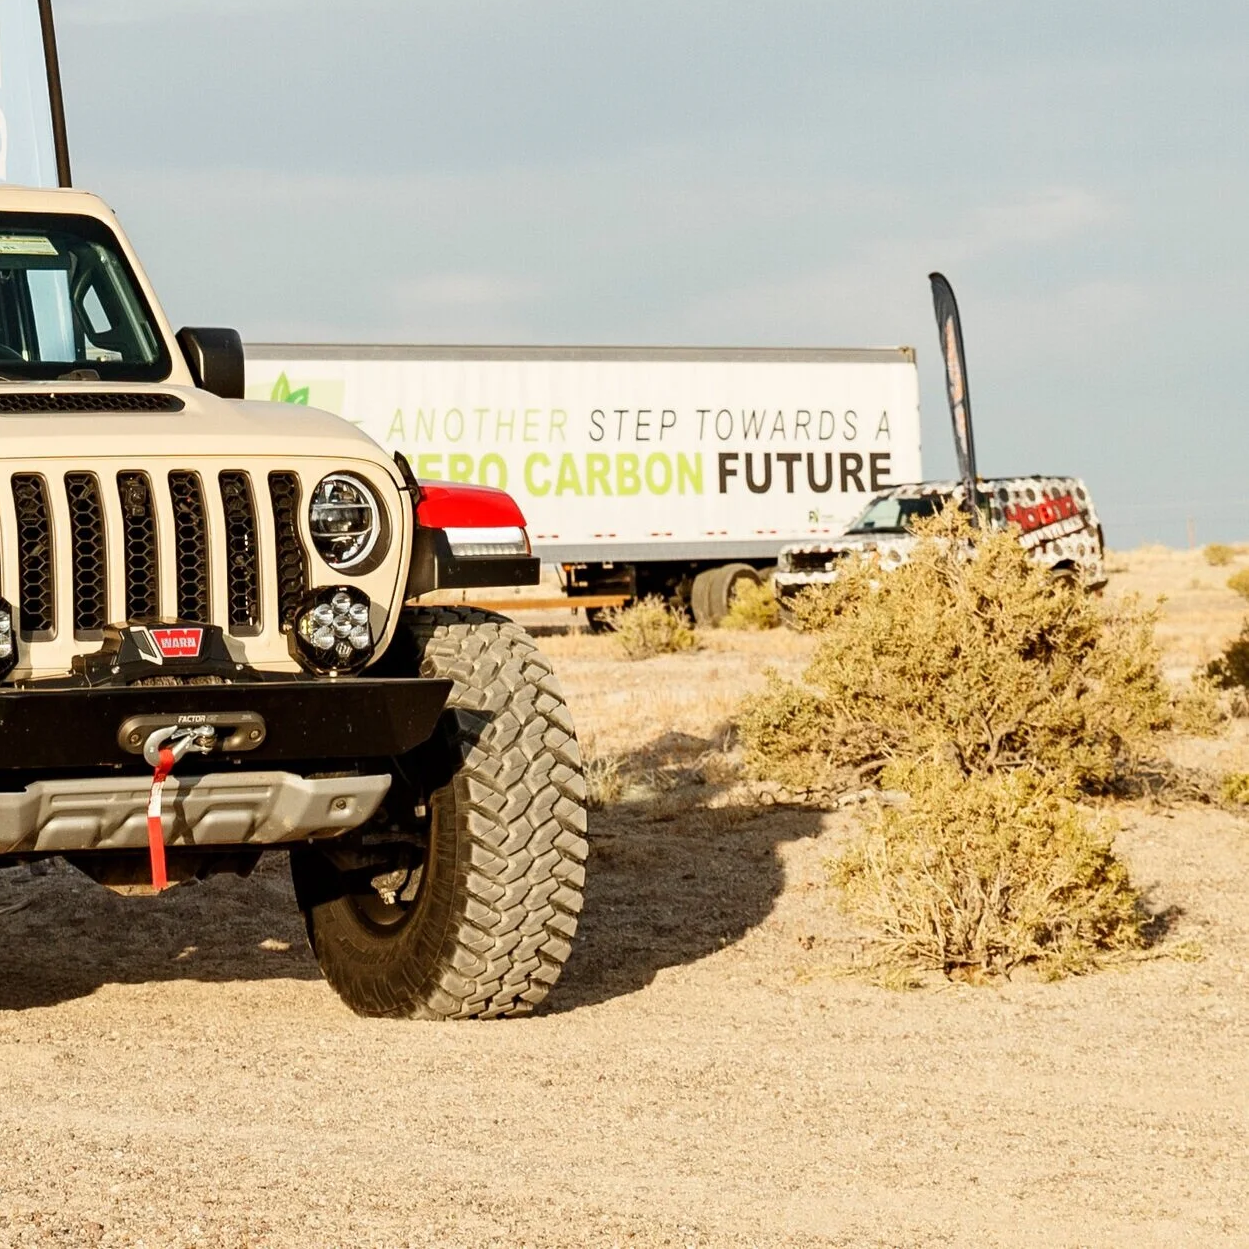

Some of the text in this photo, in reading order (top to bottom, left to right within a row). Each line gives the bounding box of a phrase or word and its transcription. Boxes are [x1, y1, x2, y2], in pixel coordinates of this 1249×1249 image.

[386, 408, 892, 442] ANOTHER STEP TOWARDS A
[524, 453, 704, 497] CARBON
[718, 452, 892, 494] FUTURE
[161, 637, 197, 649] WARN
